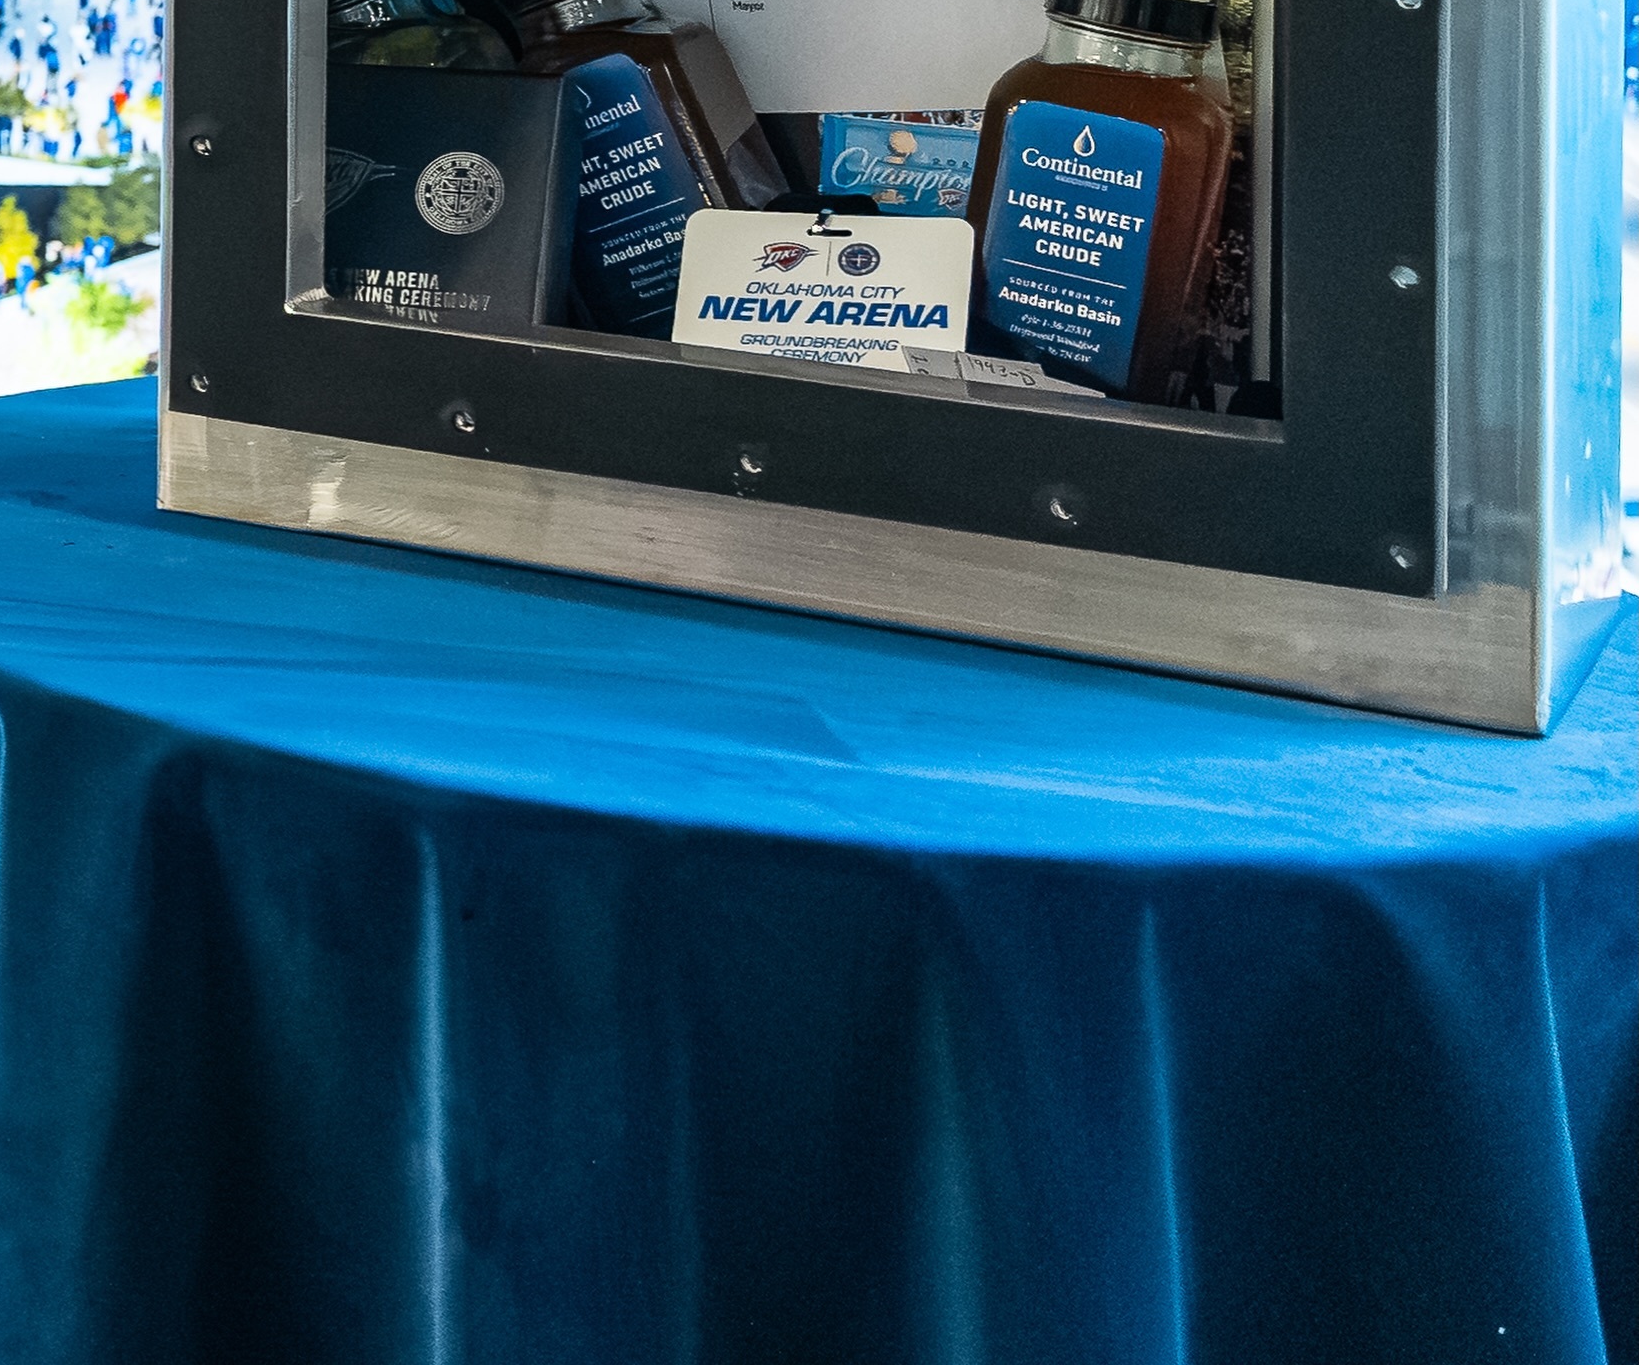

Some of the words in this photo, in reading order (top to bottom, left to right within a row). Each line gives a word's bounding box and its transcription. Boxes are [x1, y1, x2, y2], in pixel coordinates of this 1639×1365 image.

[608, 132, 665, 164] SWEET
[578, 156, 662, 197] AMERICAN
[1021, 147, 1143, 190] Continental
[600, 180, 656, 211] CRUDE
[1007, 189, 1069, 219] LIGHT,
[1074, 204, 1145, 233] SWEET
[1018, 214, 1124, 250] AMERICAN
[602, 237, 664, 267] Anadarko
[763, 248, 800, 265] OKC
[1035, 239, 1102, 267] CRUDE
[385, 270, 440, 290] ARENA
[746, 281, 854, 299] OKLAHOMA
[860, 286, 906, 300] CITY
[1009, 276, 1058, 294] SOURCED
[1061, 288, 1091, 301] FROM
[1094, 295, 1116, 307] THE
[698, 295, 802, 322] NEW
[805, 300, 949, 329] ARENA
[998, 285, 1074, 316] Anadarko
[1077, 303, 1122, 327] Basin
[740, 333, 899, 352] GROUNDBREAKING
